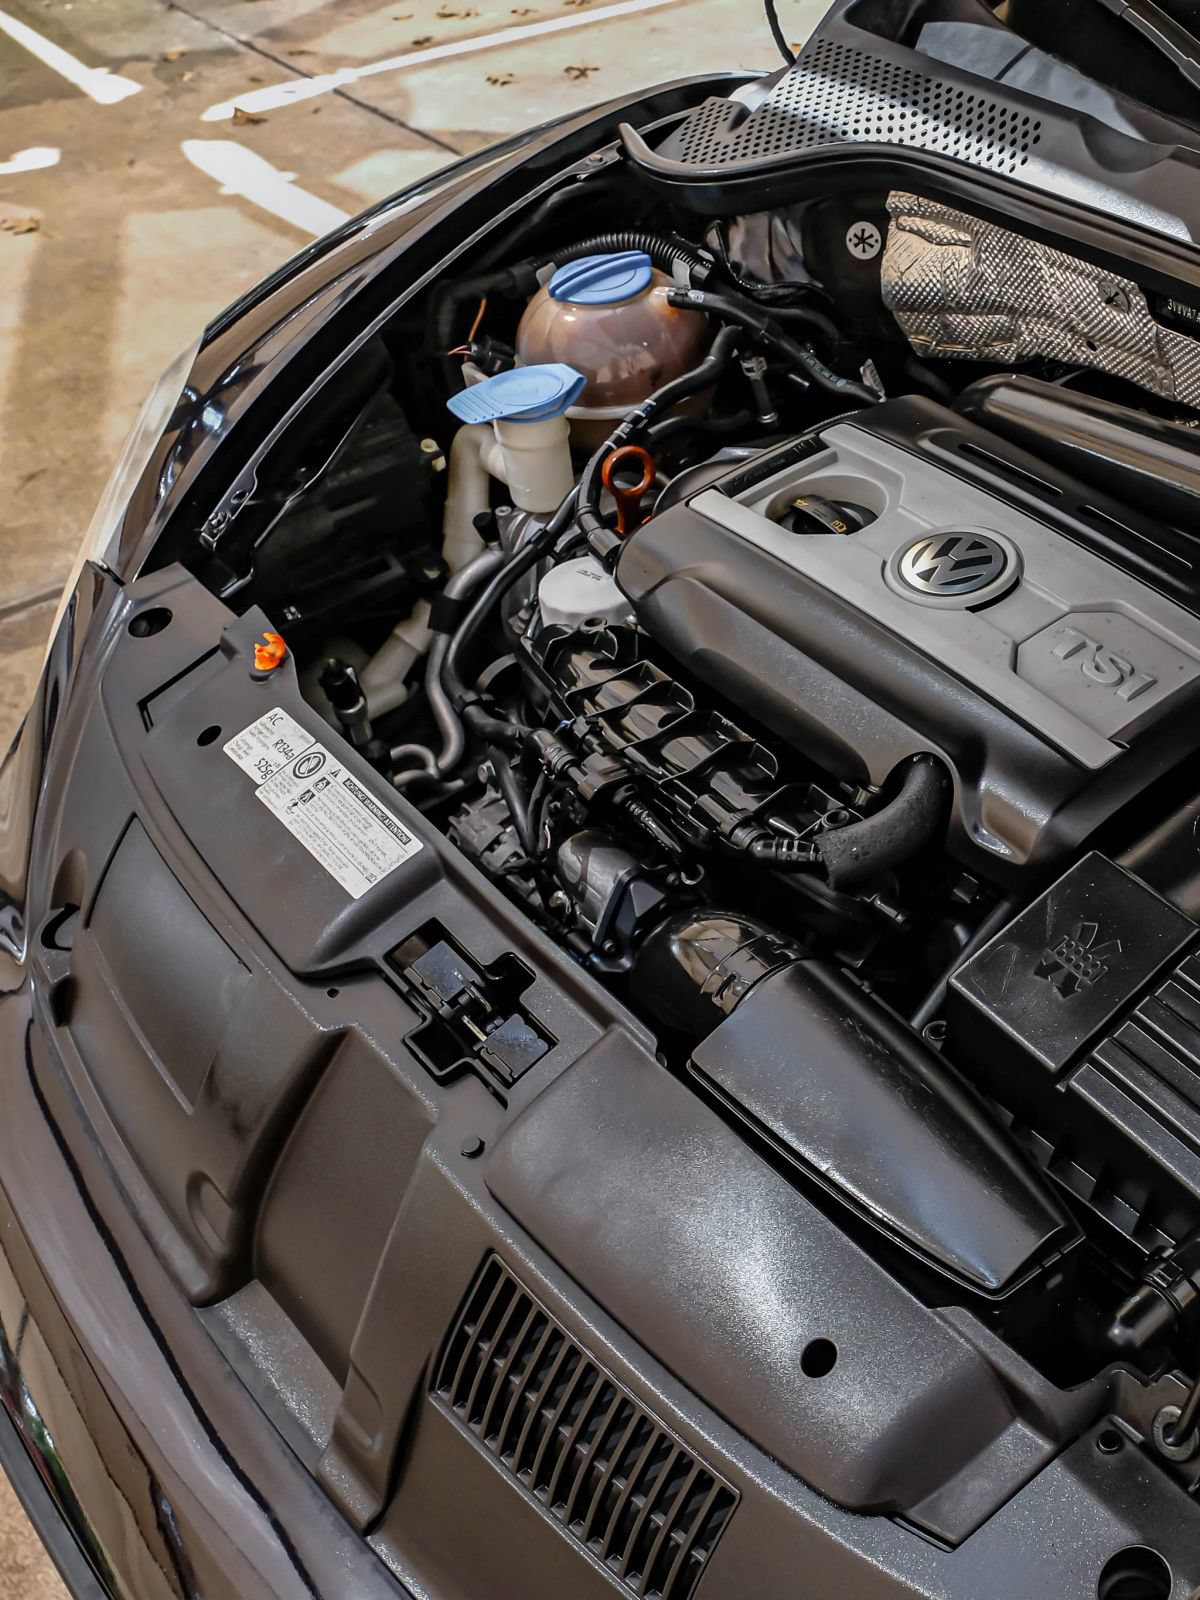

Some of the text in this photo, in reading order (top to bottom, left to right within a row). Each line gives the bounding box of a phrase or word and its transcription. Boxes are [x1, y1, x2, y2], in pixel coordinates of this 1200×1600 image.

[1052, 626, 1158, 702] TSI
[268, 712, 284, 726] AC
[274, 738, 295, 760] R134a
[254, 757, 274, 780] 525g
